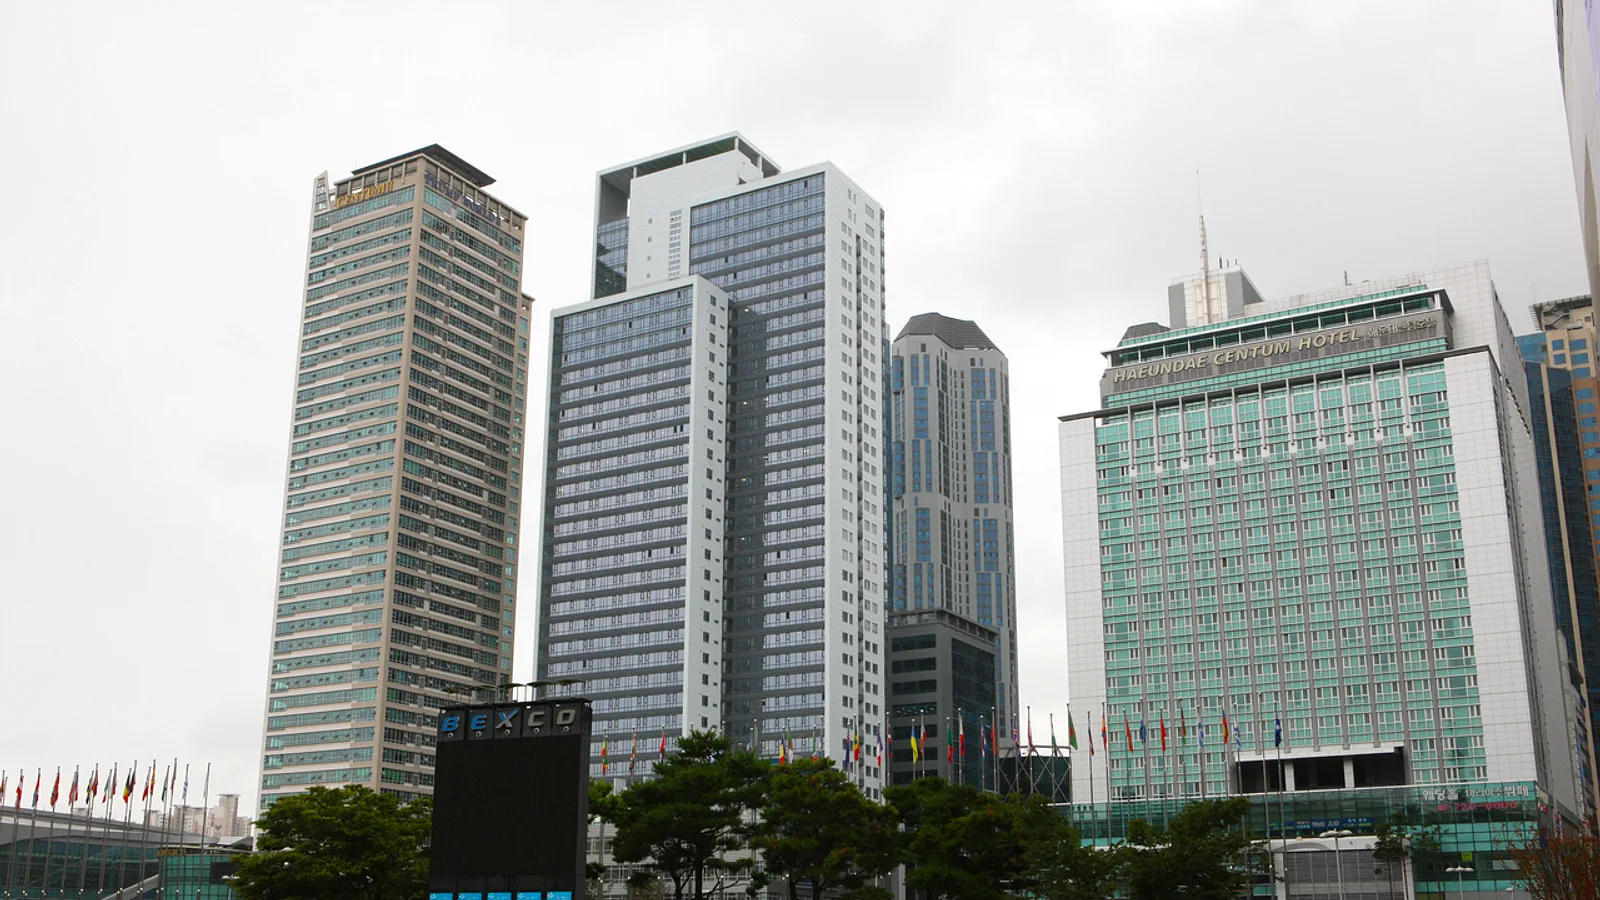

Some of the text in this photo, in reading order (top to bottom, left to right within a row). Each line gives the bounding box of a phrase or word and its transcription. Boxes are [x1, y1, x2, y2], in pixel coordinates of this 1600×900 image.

[1113, 328, 1361, 383] HAEUNDAE CENTUM HOTEL
[441, 708, 576, 732] BEXCO
[1422, 789, 1459, 801] 웨딩홀
